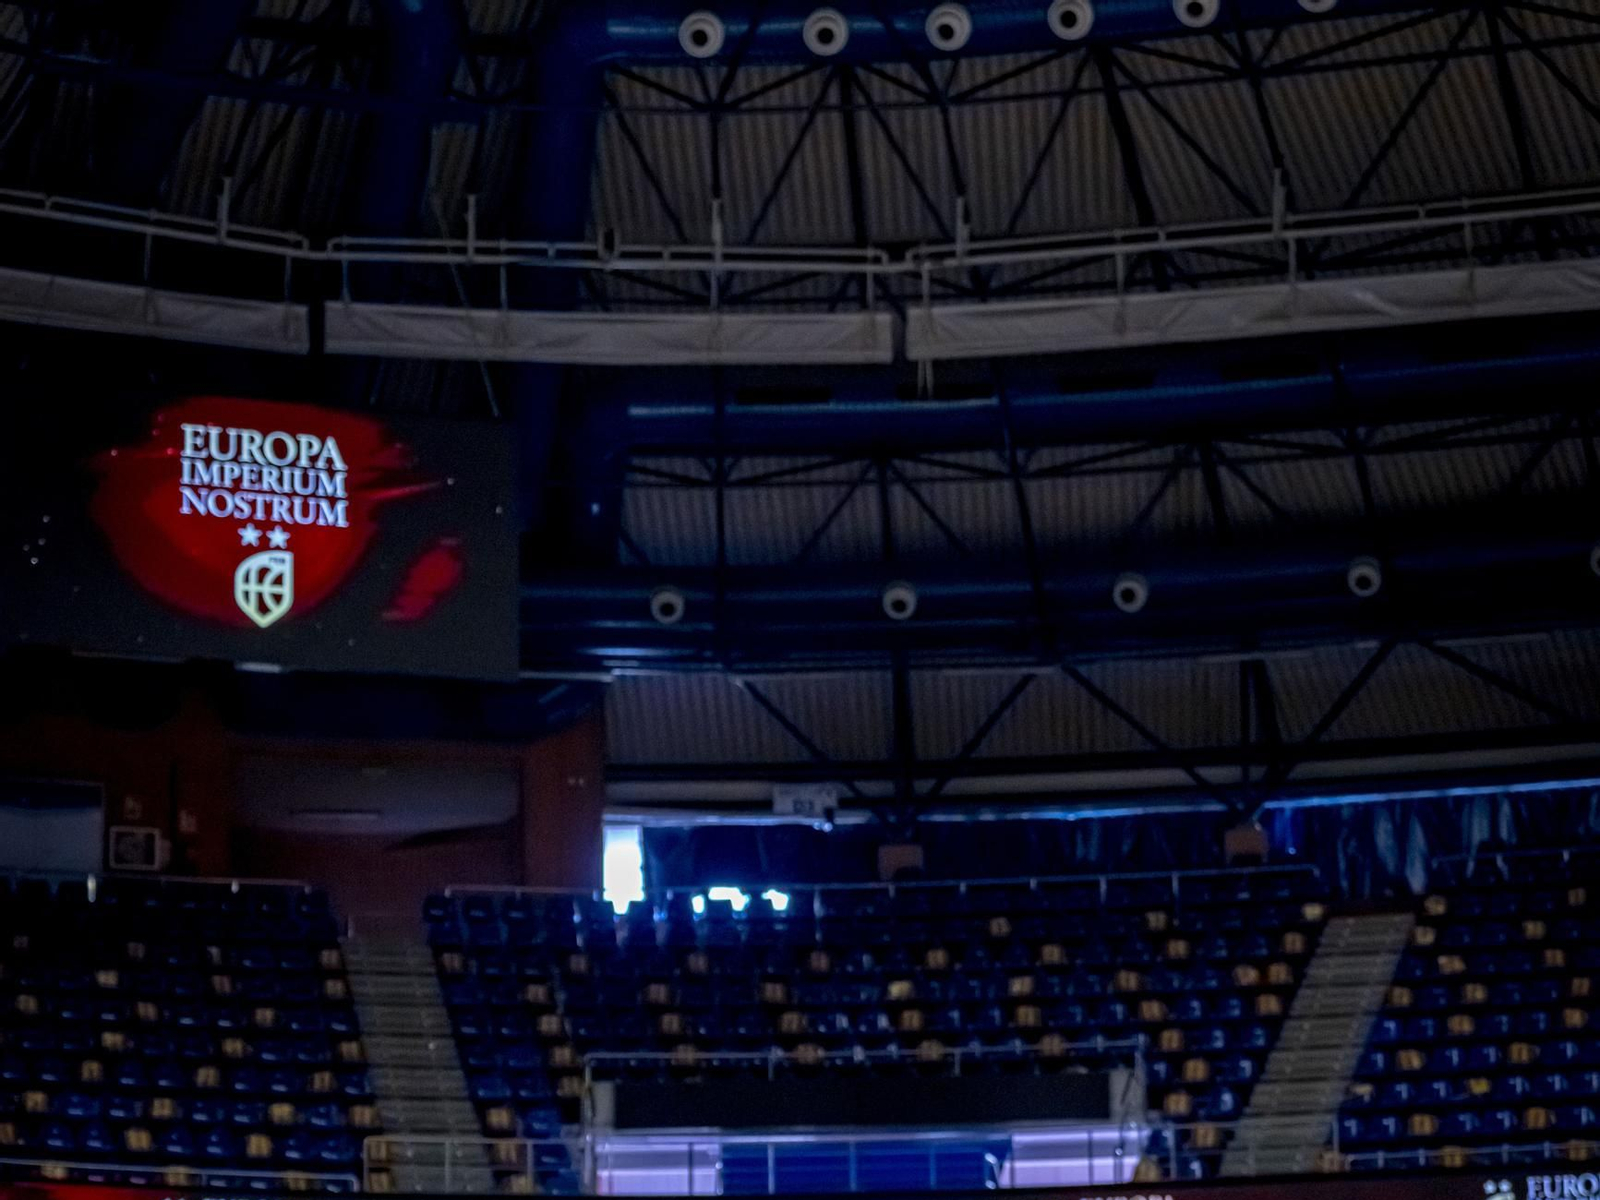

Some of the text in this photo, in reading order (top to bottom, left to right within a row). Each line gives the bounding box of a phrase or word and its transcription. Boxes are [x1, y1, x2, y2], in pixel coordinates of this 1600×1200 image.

[181, 423, 348, 471] EUROPA
[180, 458, 348, 498] IMPERIUM
[179, 486, 349, 528] NOSTRUM
[1526, 1173, 1600, 1198] EURO
